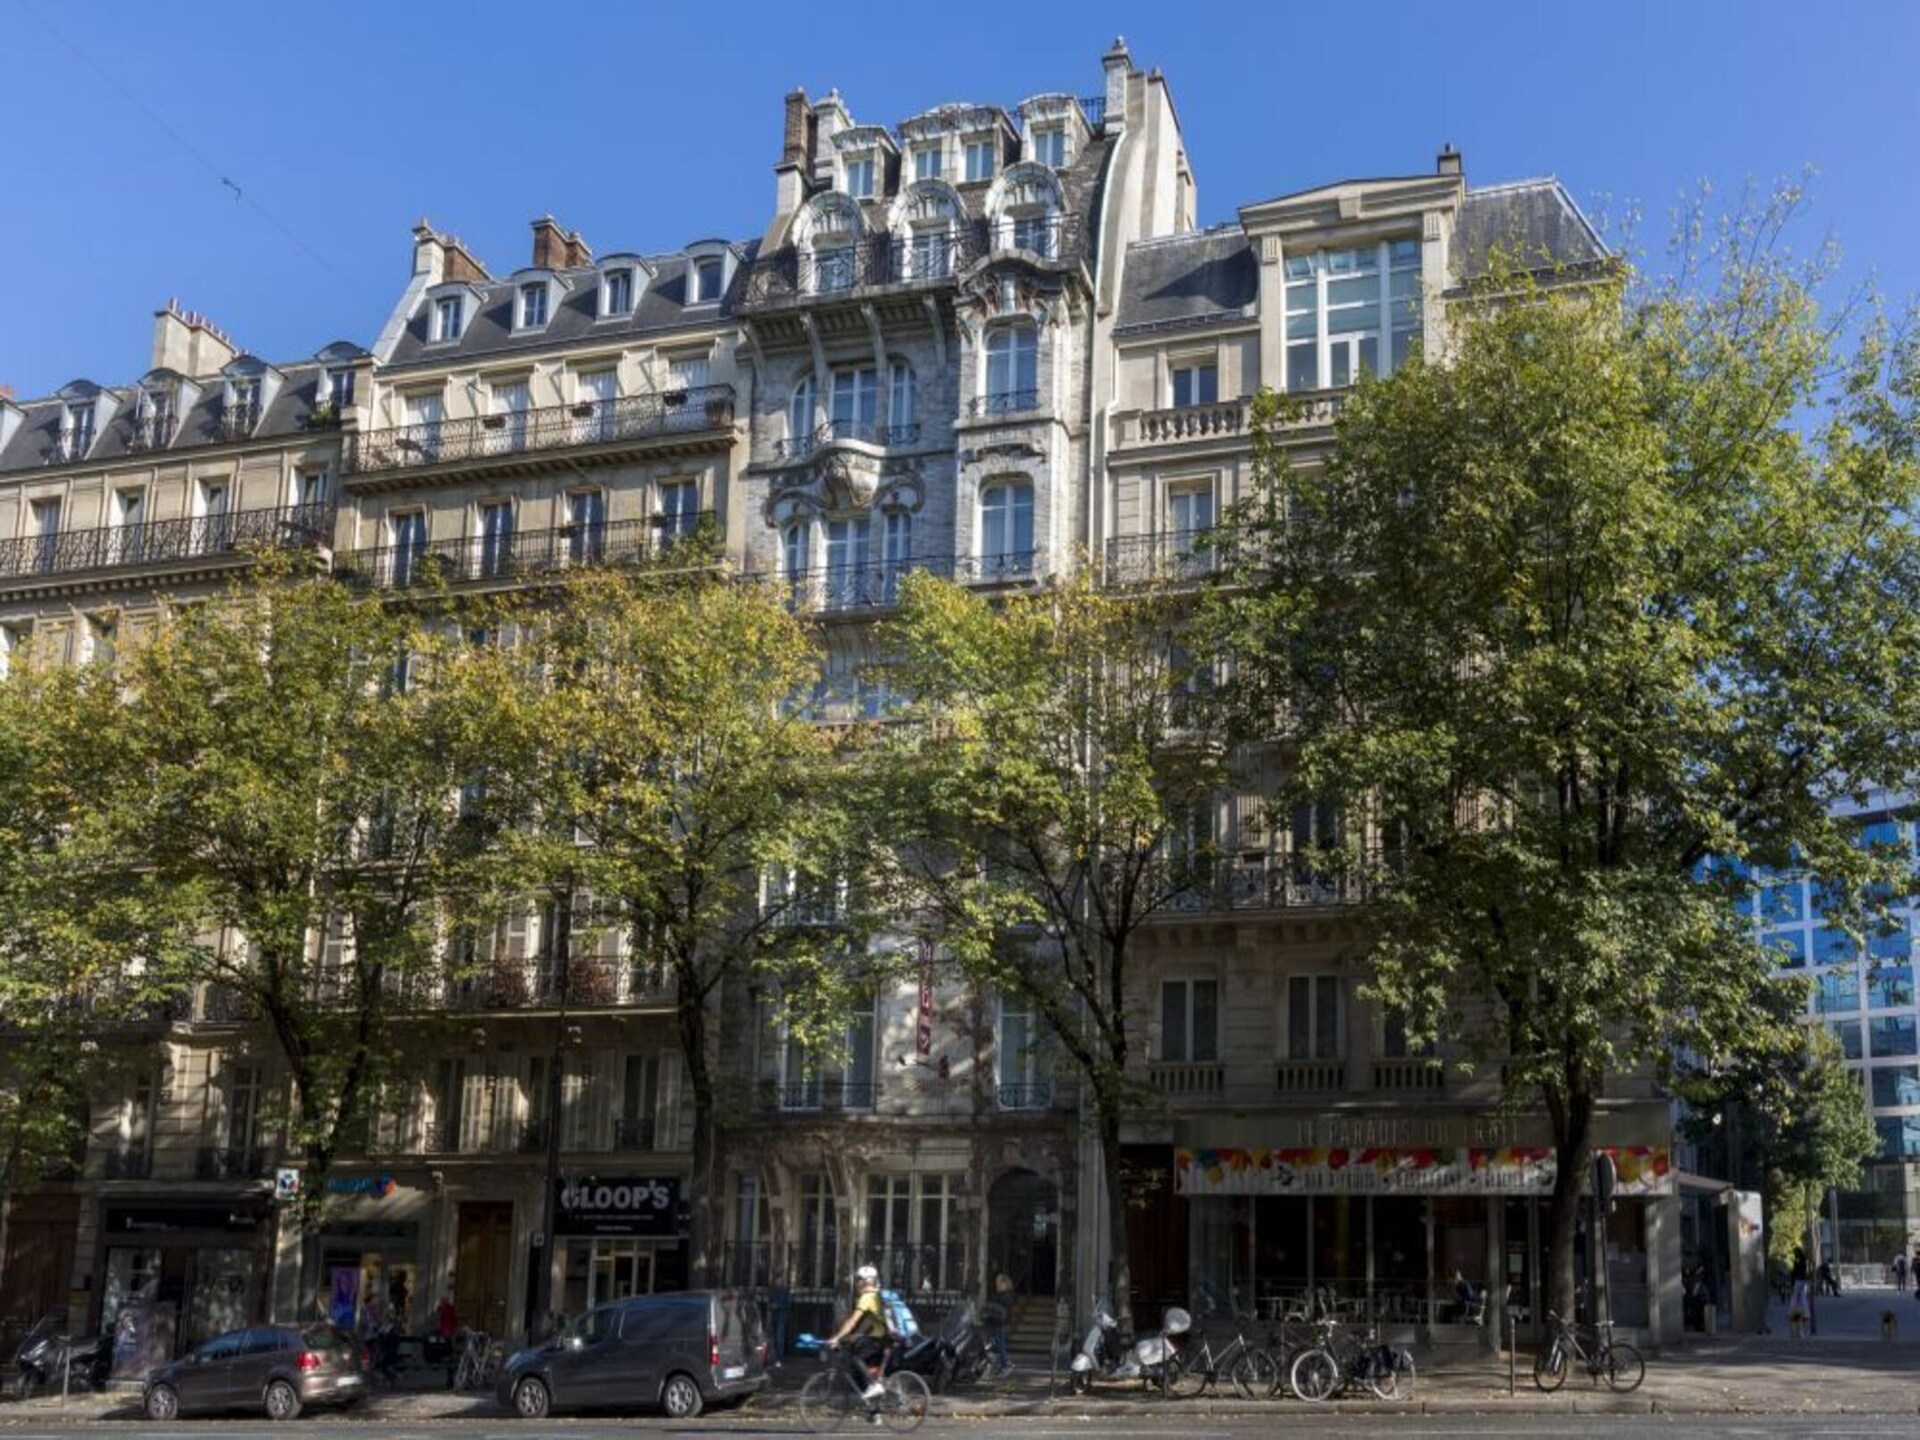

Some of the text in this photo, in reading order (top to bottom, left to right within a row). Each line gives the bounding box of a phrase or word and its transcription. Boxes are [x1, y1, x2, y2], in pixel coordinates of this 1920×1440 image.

[1296, 1120, 1314, 1145] LE
[1328, 1119, 1411, 1145] PARADIS
[1425, 1121, 1449, 1145] DU
[560, 1180, 670, 1210] GLOOP'S
